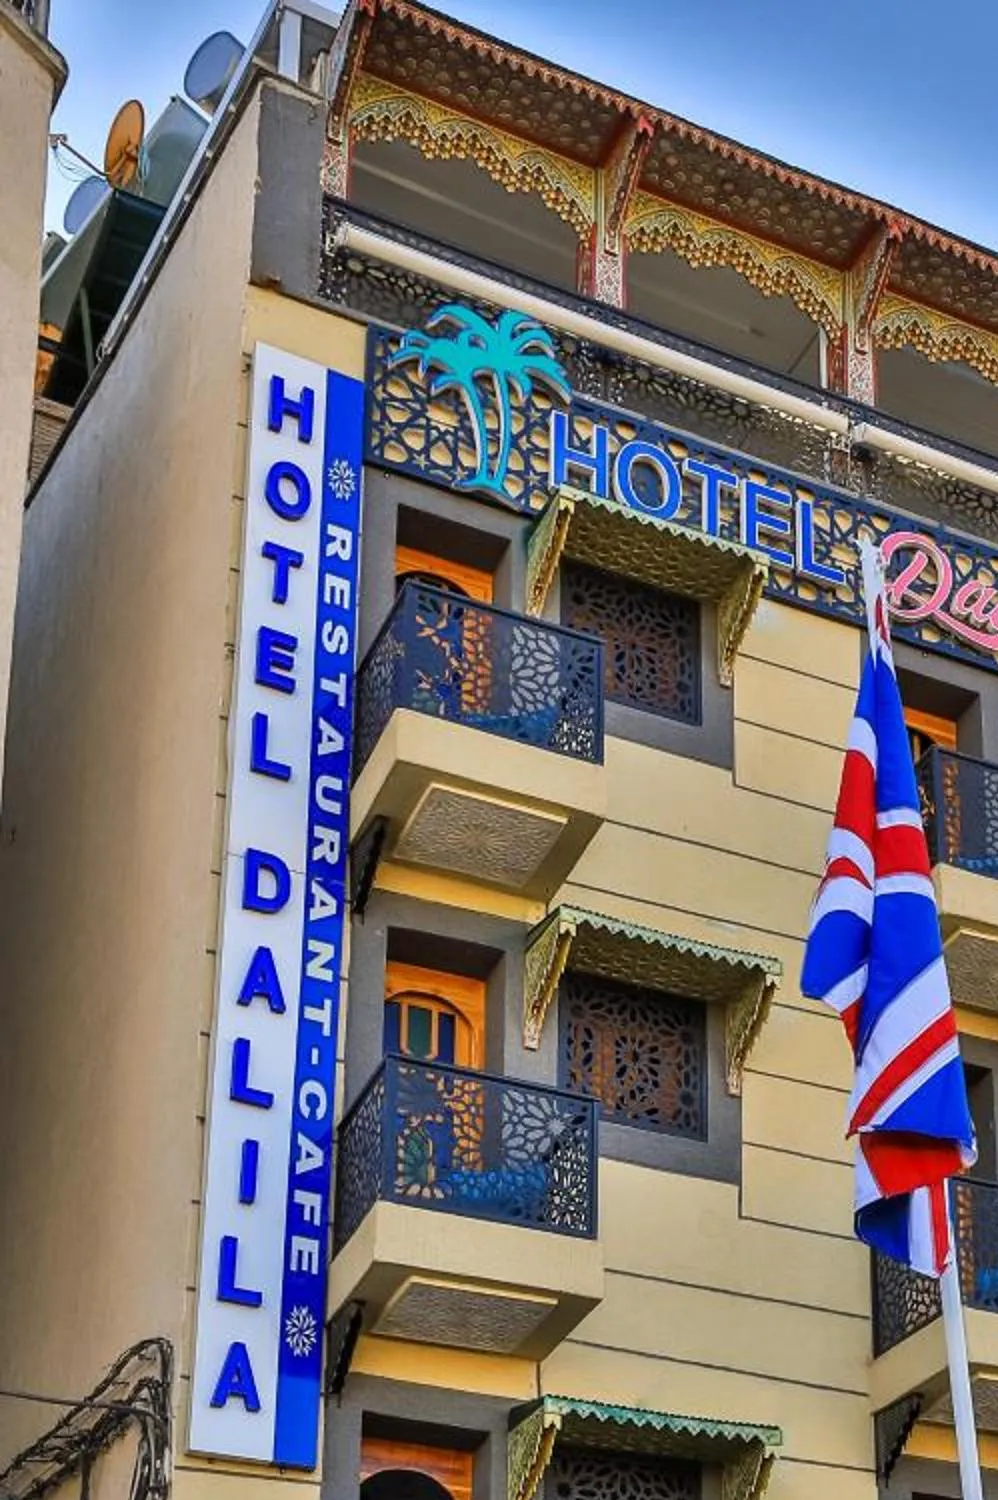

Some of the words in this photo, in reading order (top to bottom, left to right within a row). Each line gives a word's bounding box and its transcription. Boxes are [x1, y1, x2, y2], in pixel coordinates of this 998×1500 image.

[251, 374, 315, 782] HOTEL
[548, 408, 848, 585] HOTEL
[210, 847, 291, 1412] DALILA
